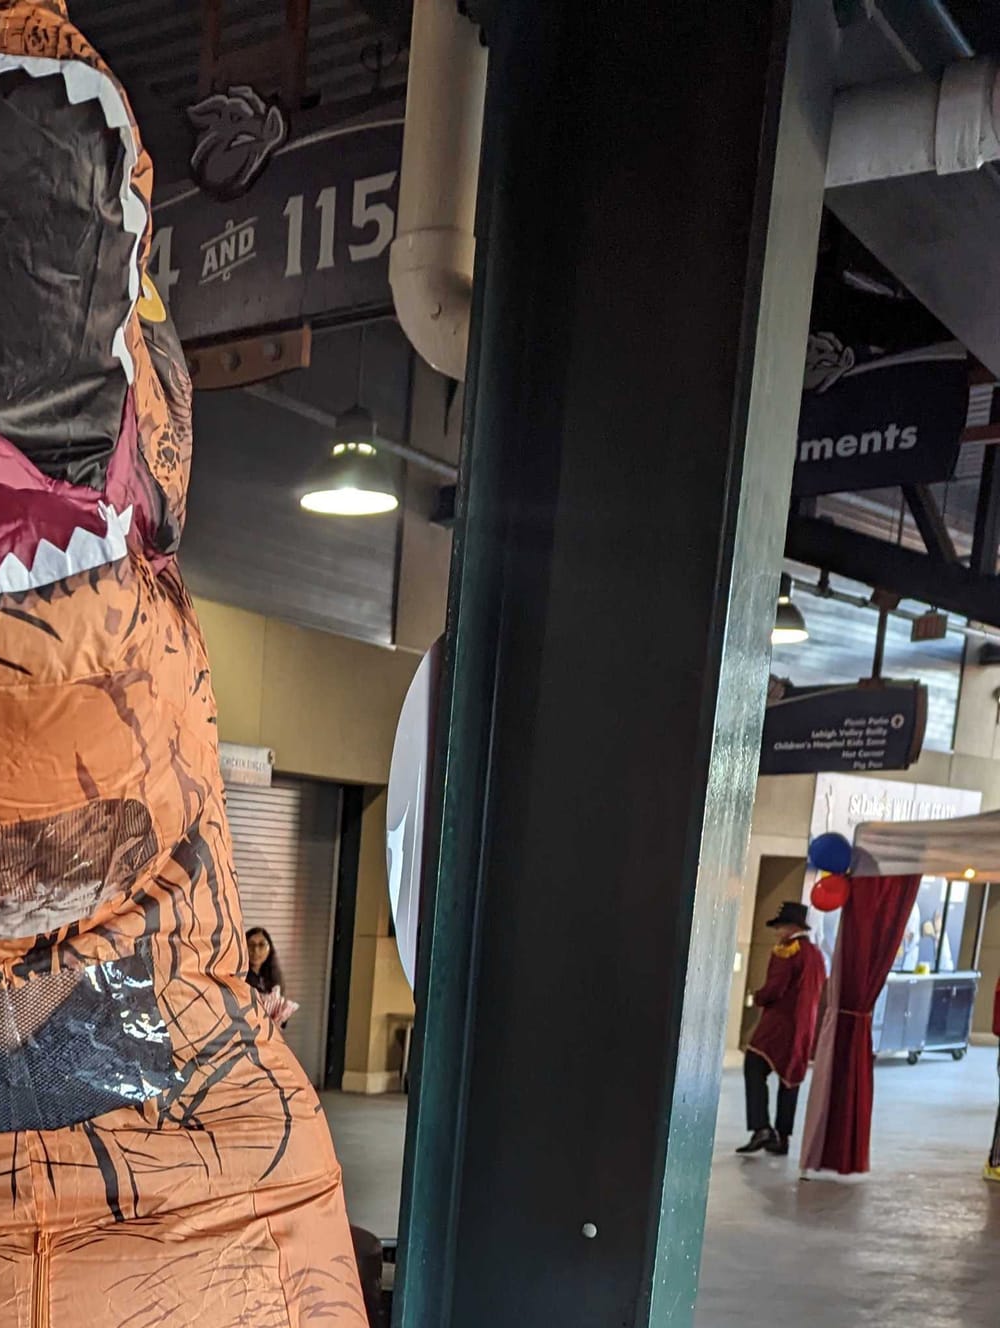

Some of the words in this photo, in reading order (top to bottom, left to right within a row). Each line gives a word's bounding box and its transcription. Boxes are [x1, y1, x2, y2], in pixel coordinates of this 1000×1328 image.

[202, 226, 255, 278] AND
[283, 171, 398, 278] 115
[801, 424, 918, 462] ments
